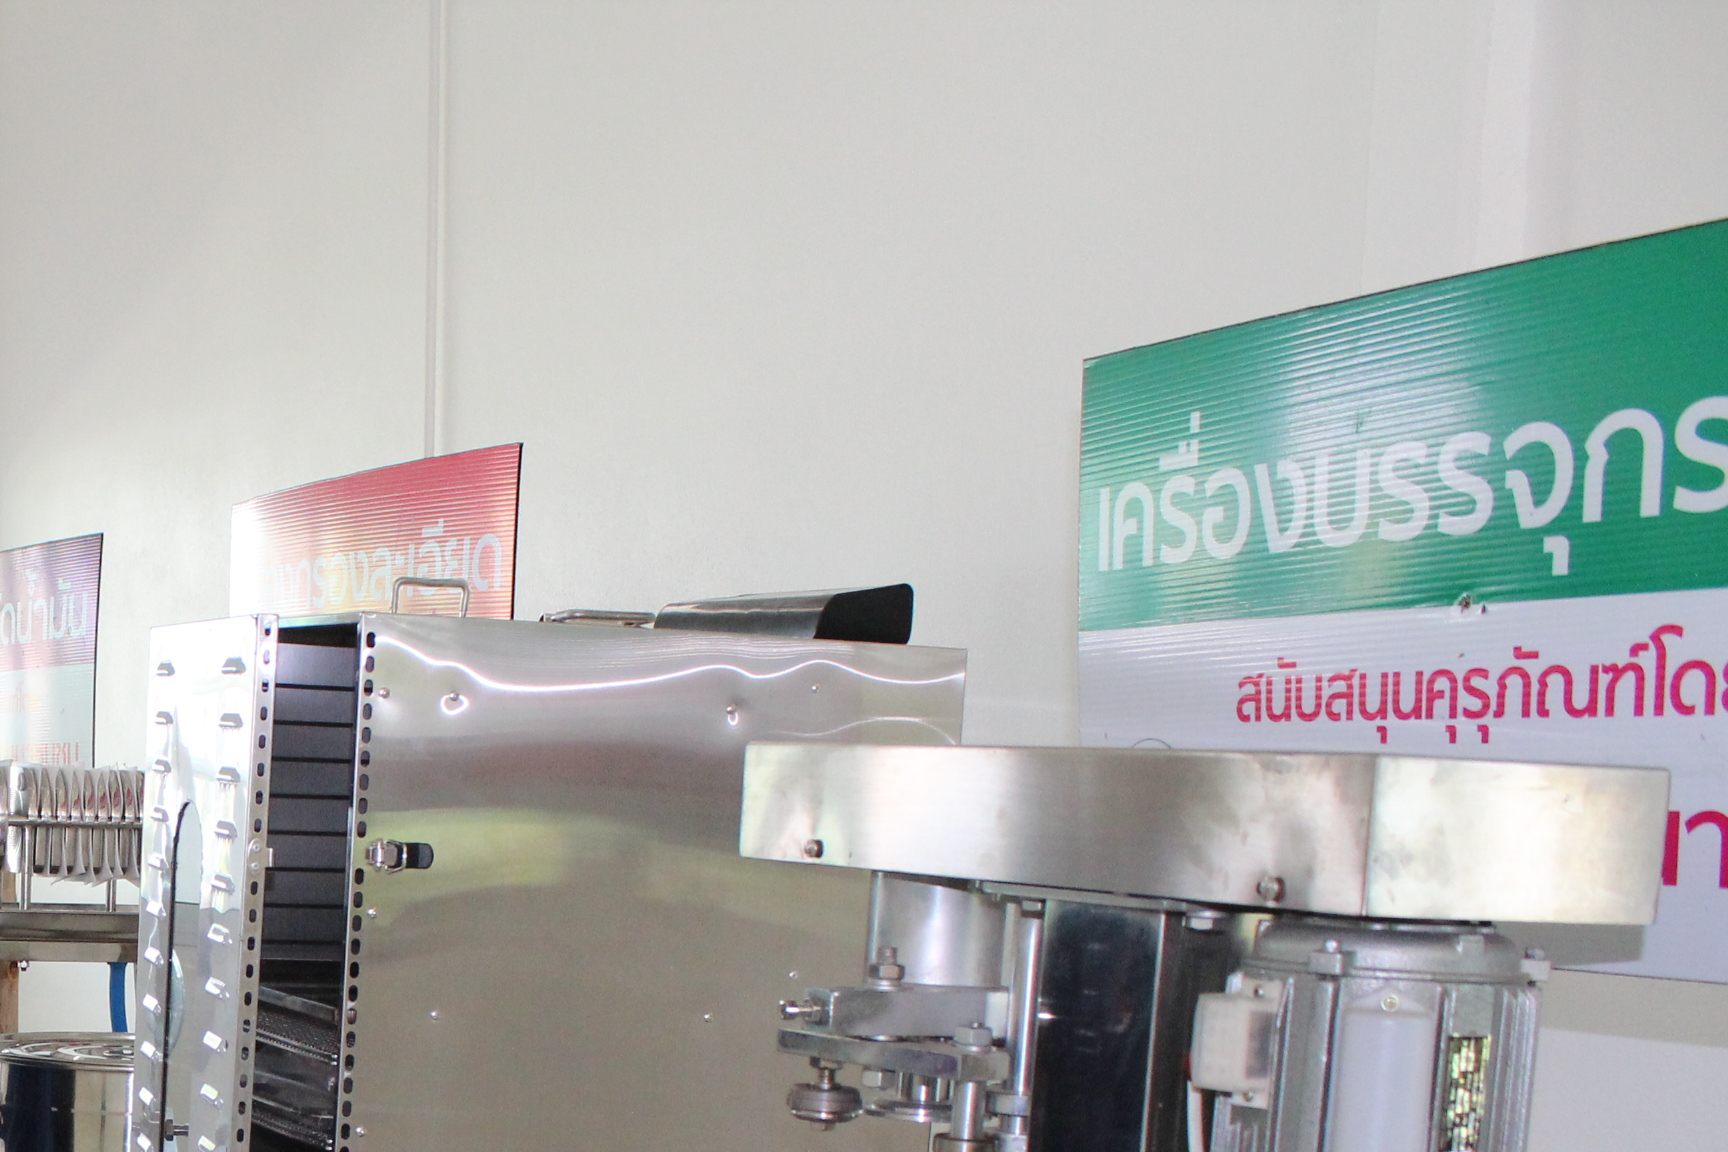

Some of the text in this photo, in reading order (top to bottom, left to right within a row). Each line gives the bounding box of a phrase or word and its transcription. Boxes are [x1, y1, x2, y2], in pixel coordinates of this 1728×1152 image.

[1236, 625, 1728, 744] สนับสนุนคุรุภัณฑ์โด
